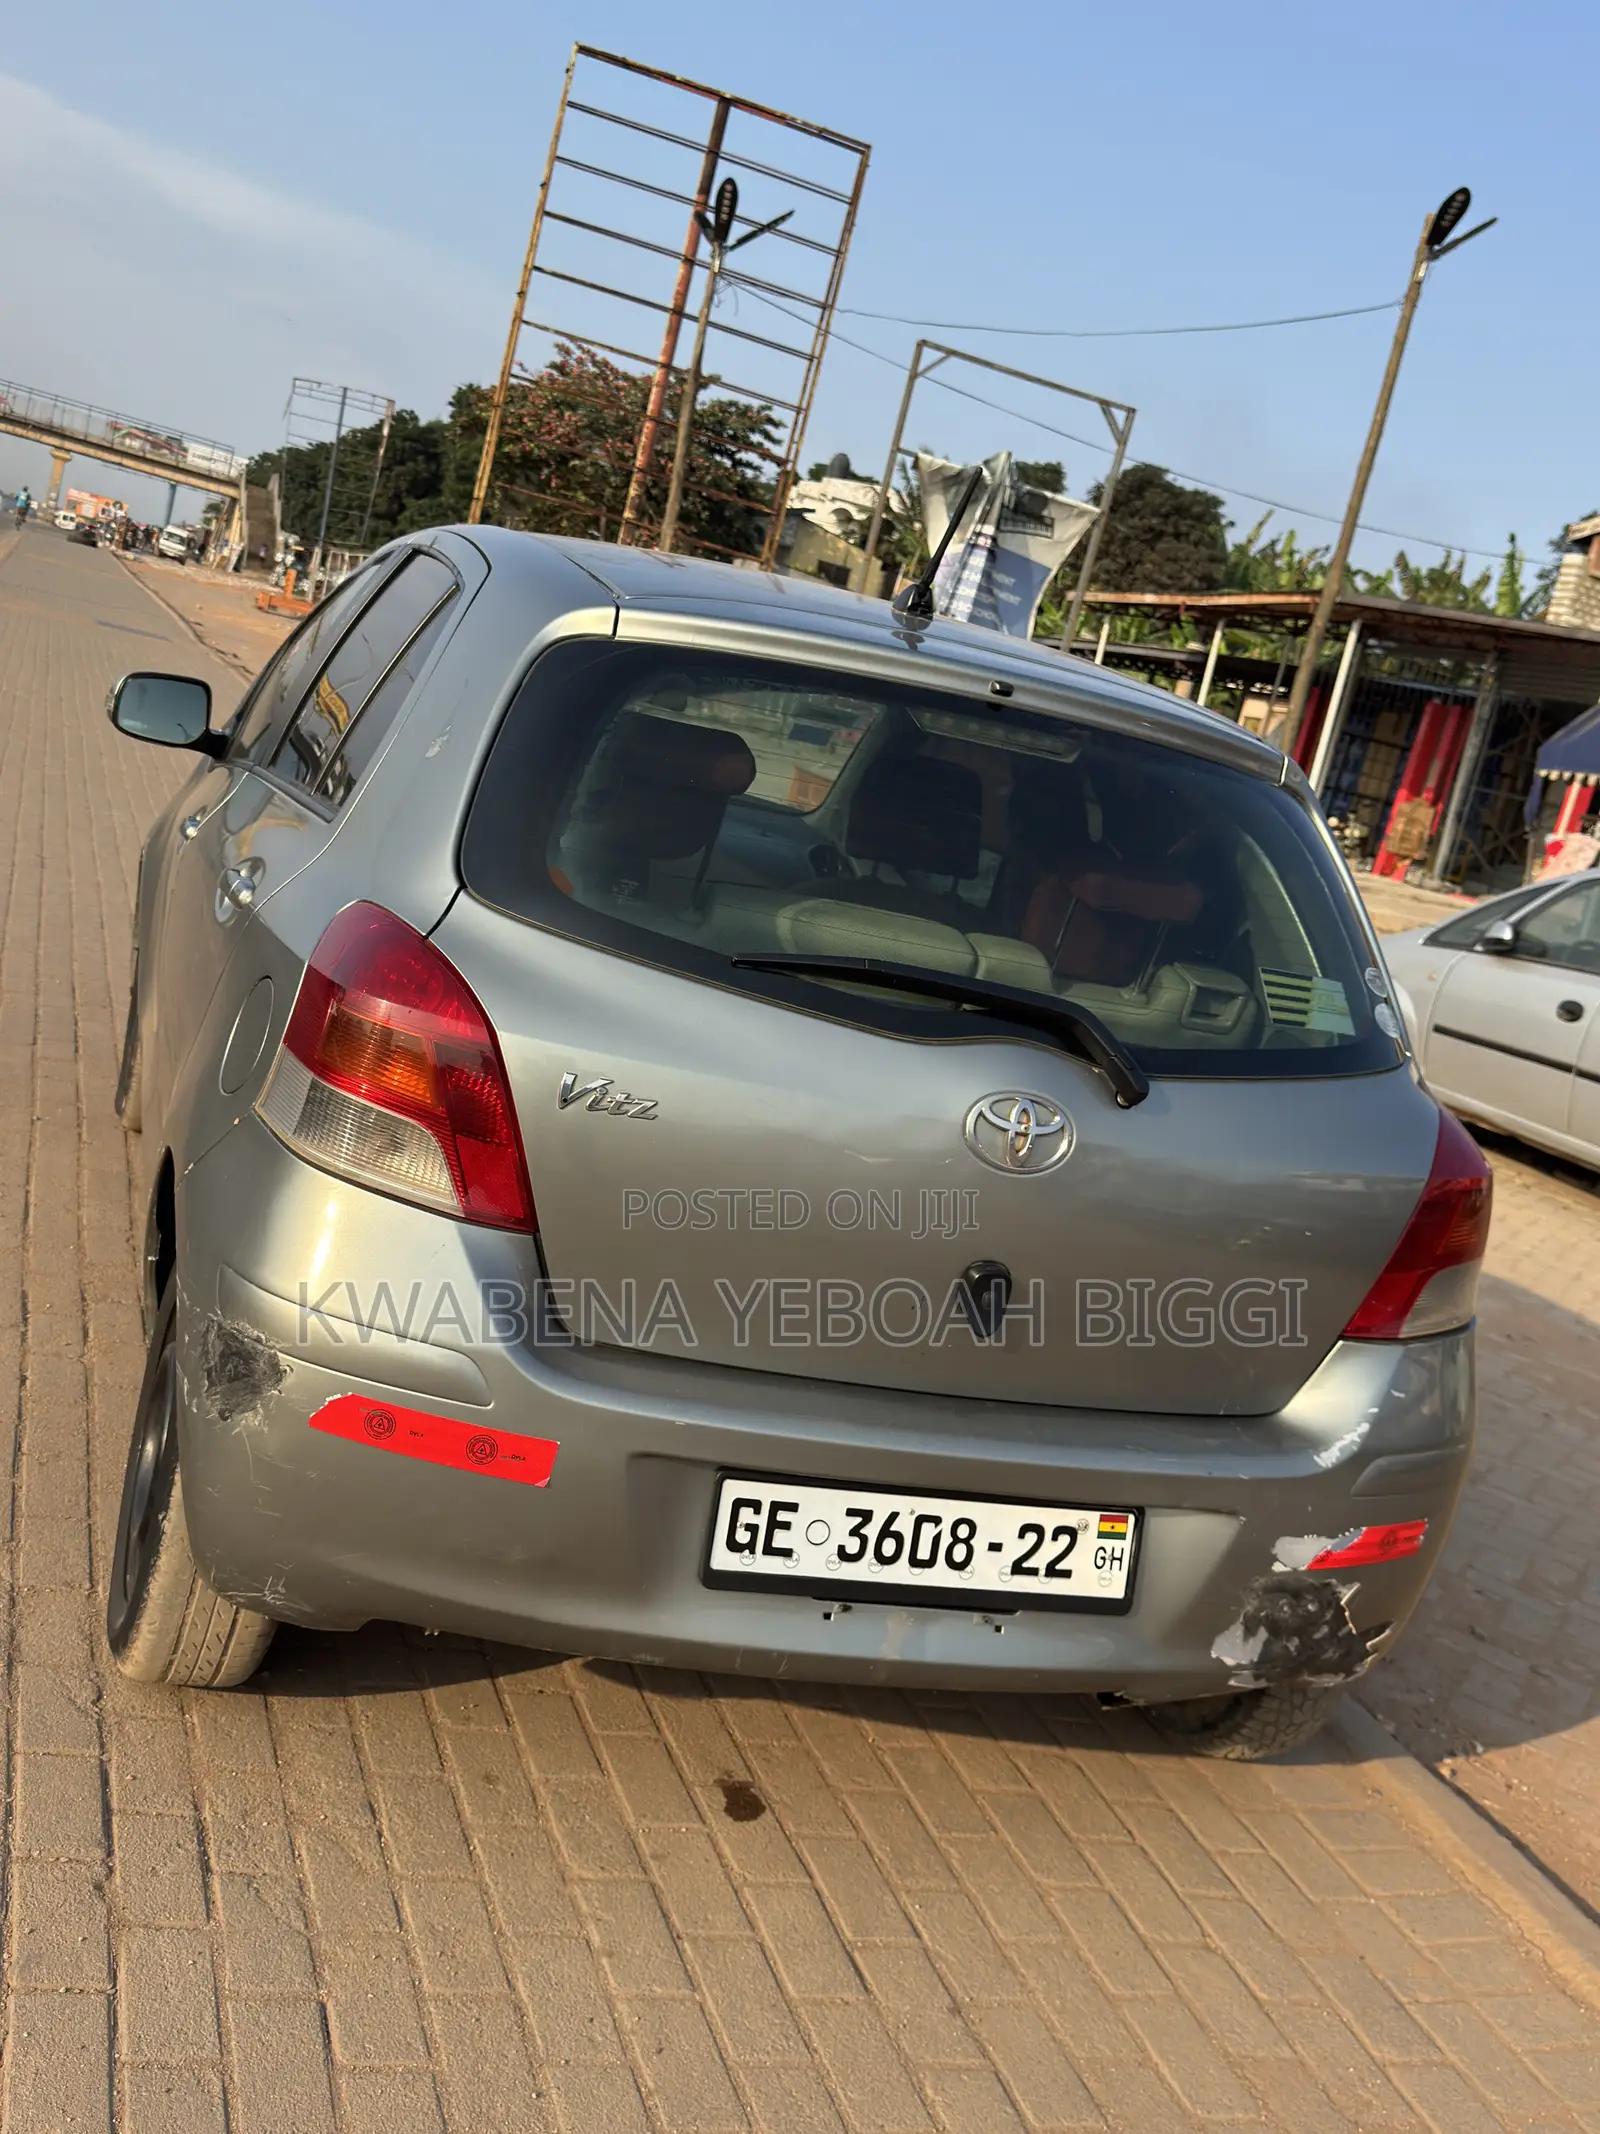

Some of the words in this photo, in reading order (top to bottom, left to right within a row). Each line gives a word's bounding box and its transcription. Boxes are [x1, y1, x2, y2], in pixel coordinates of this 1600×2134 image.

[557, 1071, 659, 1121] Vitz
[725, 1497, 800, 1558] GE
[1094, 1545, 1124, 1572] GH
